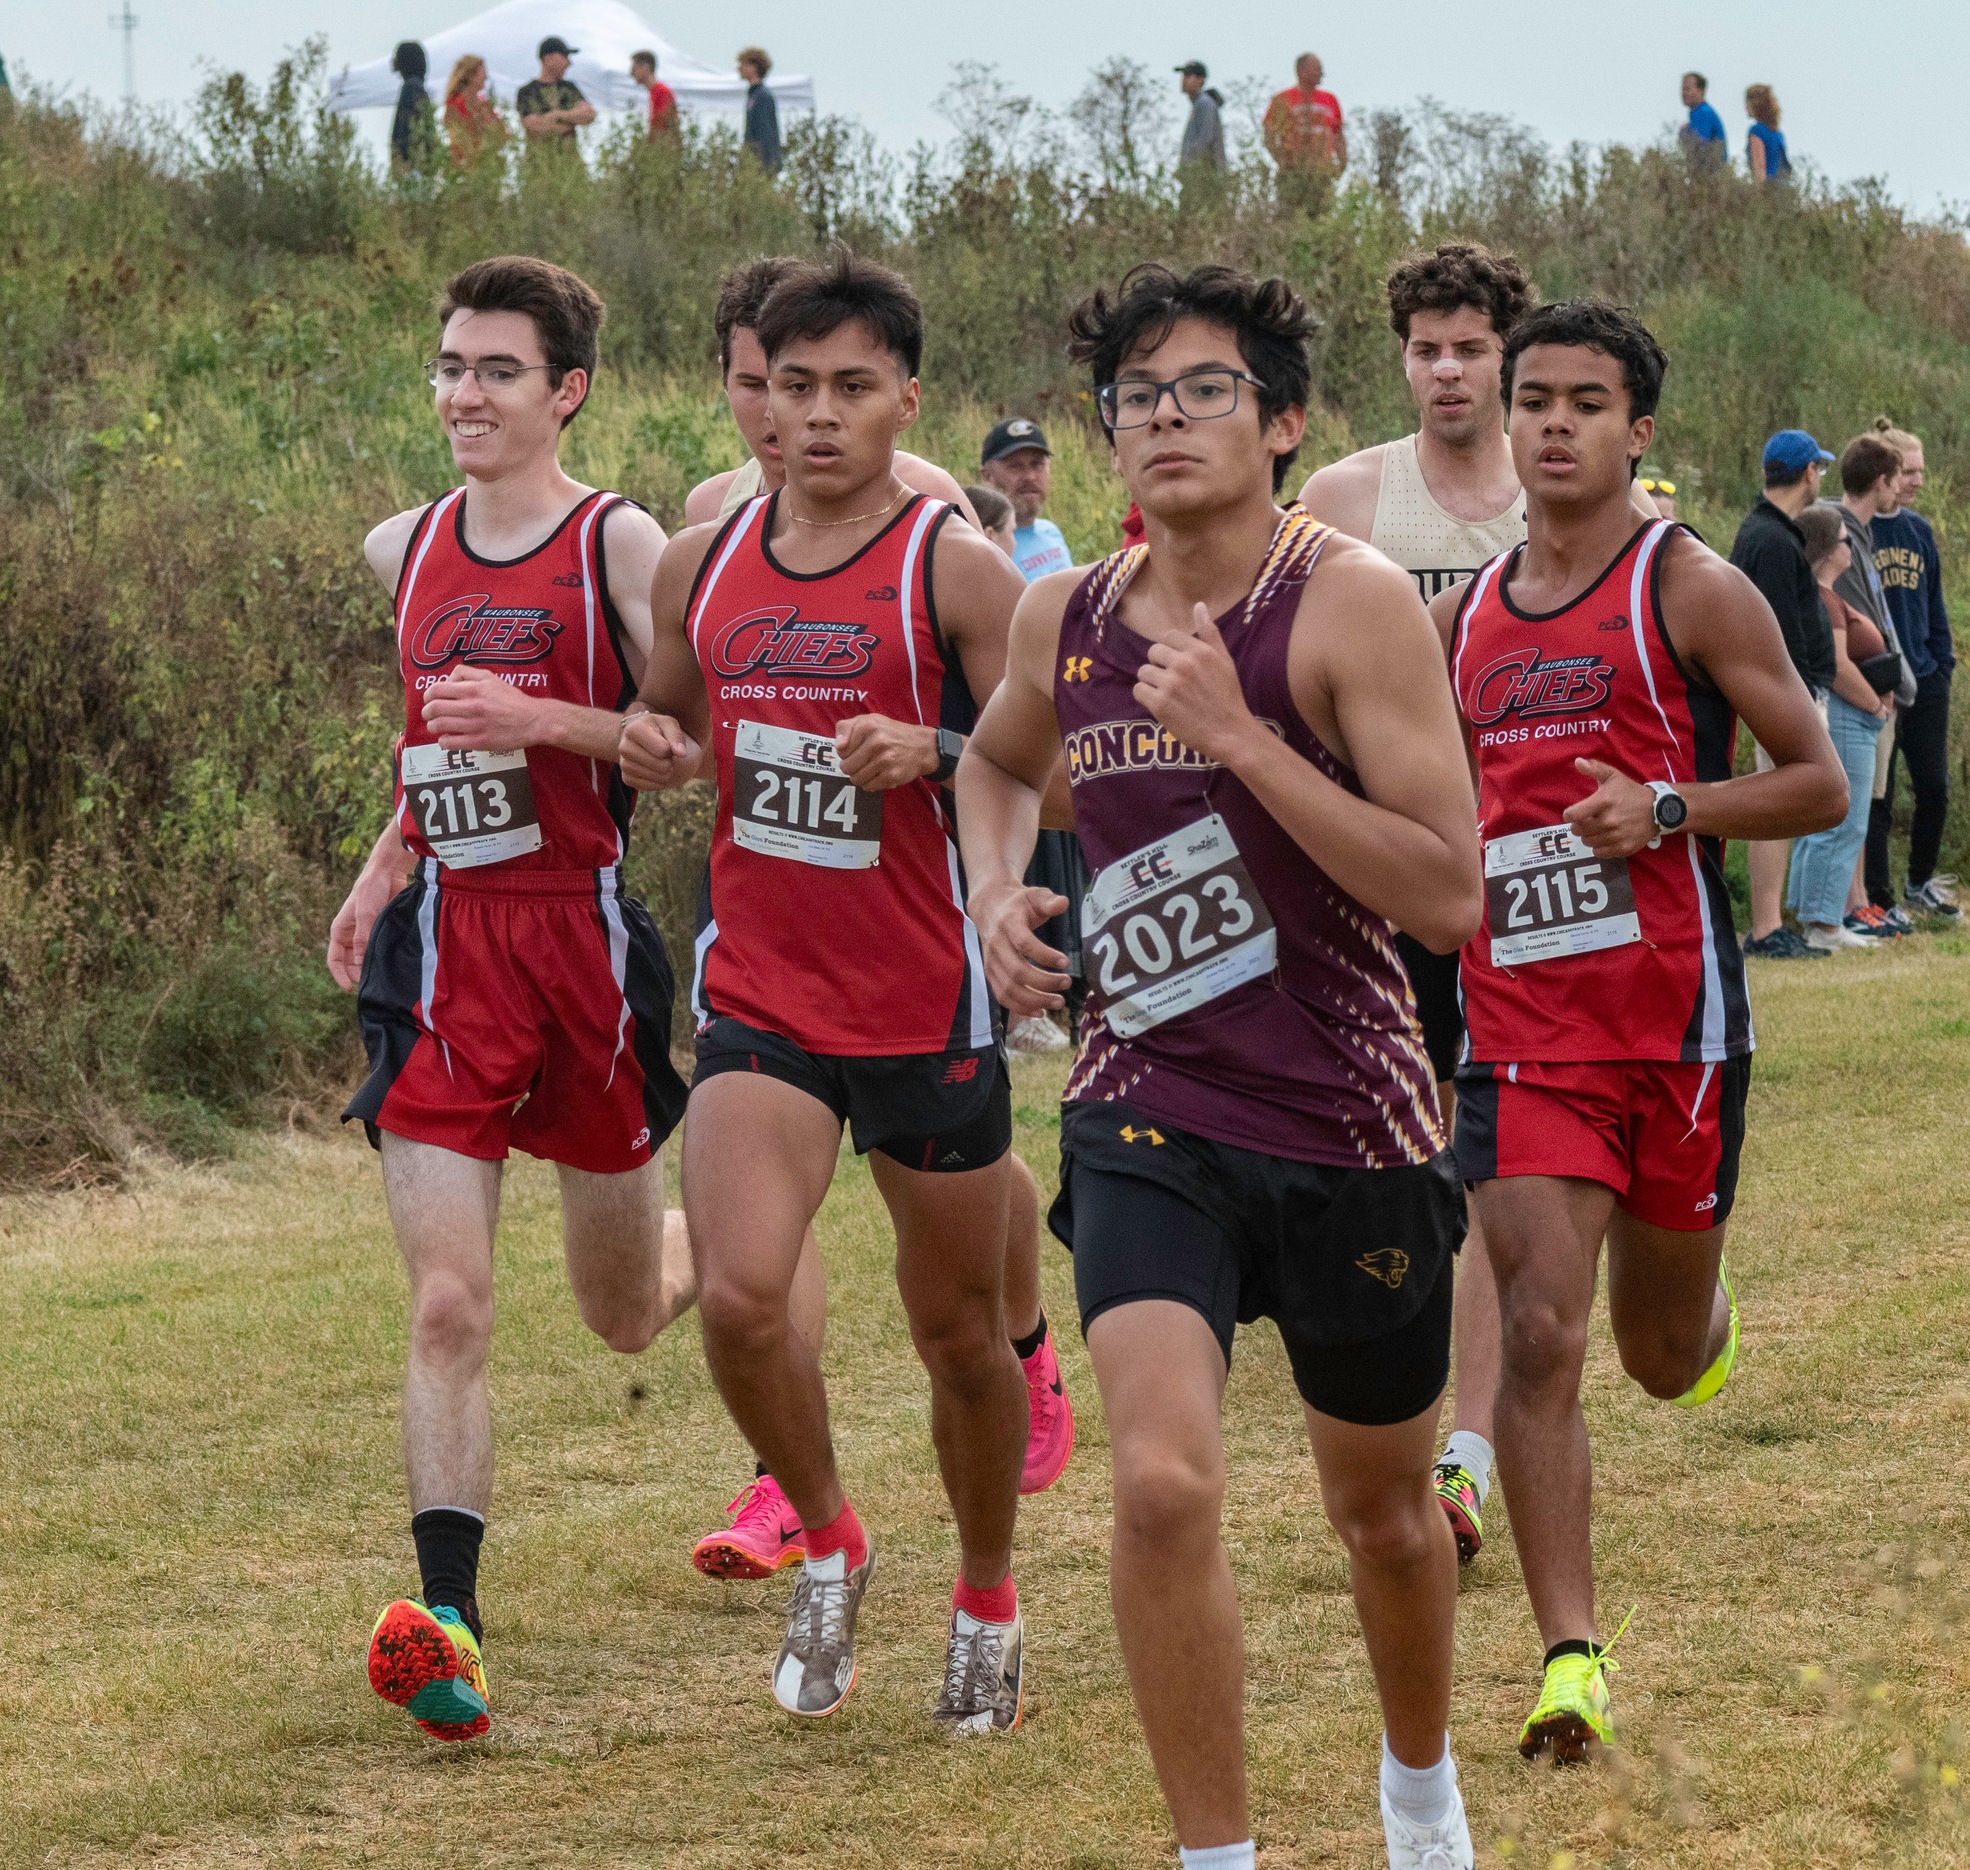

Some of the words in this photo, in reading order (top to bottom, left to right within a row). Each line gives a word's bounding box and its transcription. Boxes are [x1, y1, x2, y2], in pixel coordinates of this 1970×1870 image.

[482, 608, 544, 617] WAUBONSEE
[410, 593, 566, 669] CHIEFS
[792, 622, 859, 633] WAUBONSEE
[709, 605, 881, 680] CHIEFS
[1537, 657, 1594, 671] WAUBONSEE
[720, 685, 776, 700] CROSS
[782, 686, 868, 702] COUNTRY
[1469, 647, 1618, 728] CHIEFS
[1479, 728, 1529, 747] CROSS
[1534, 719, 1612, 739] COUNTRY
[777, 757, 792, 765] CROSS
[793, 761, 815, 770] COUNTRY
[816, 765, 836, 773] COURSE
[802, 743, 833, 767] CC
[418, 779, 512, 836] 2113
[751, 770, 858, 832] 2114
[764, 838, 799, 849] Foundation
[1532, 829, 1558, 839] SETTLER'S
[1539, 833, 1570, 857] CC
[1120, 850, 1151, 870] SETTLER'S
[1151, 843, 1169, 854] HILL
[1534, 856, 1556, 865] COUNTRY
[1556, 852, 1576, 860] COURSE
[1130, 851, 1174, 889] CC
[1111, 897, 1130, 911] CROSS
[1130, 884, 1158, 903] COUNTRY
[1158, 872, 1182, 888] COURSE
[1504, 863, 1609, 929] 2115
[1092, 874, 1255, 996] 2023
[1525, 940, 1560, 951] Foundation
[1147, 987, 1192, 1011] Foundation
[1695, 1195, 1716, 1211] PCS
